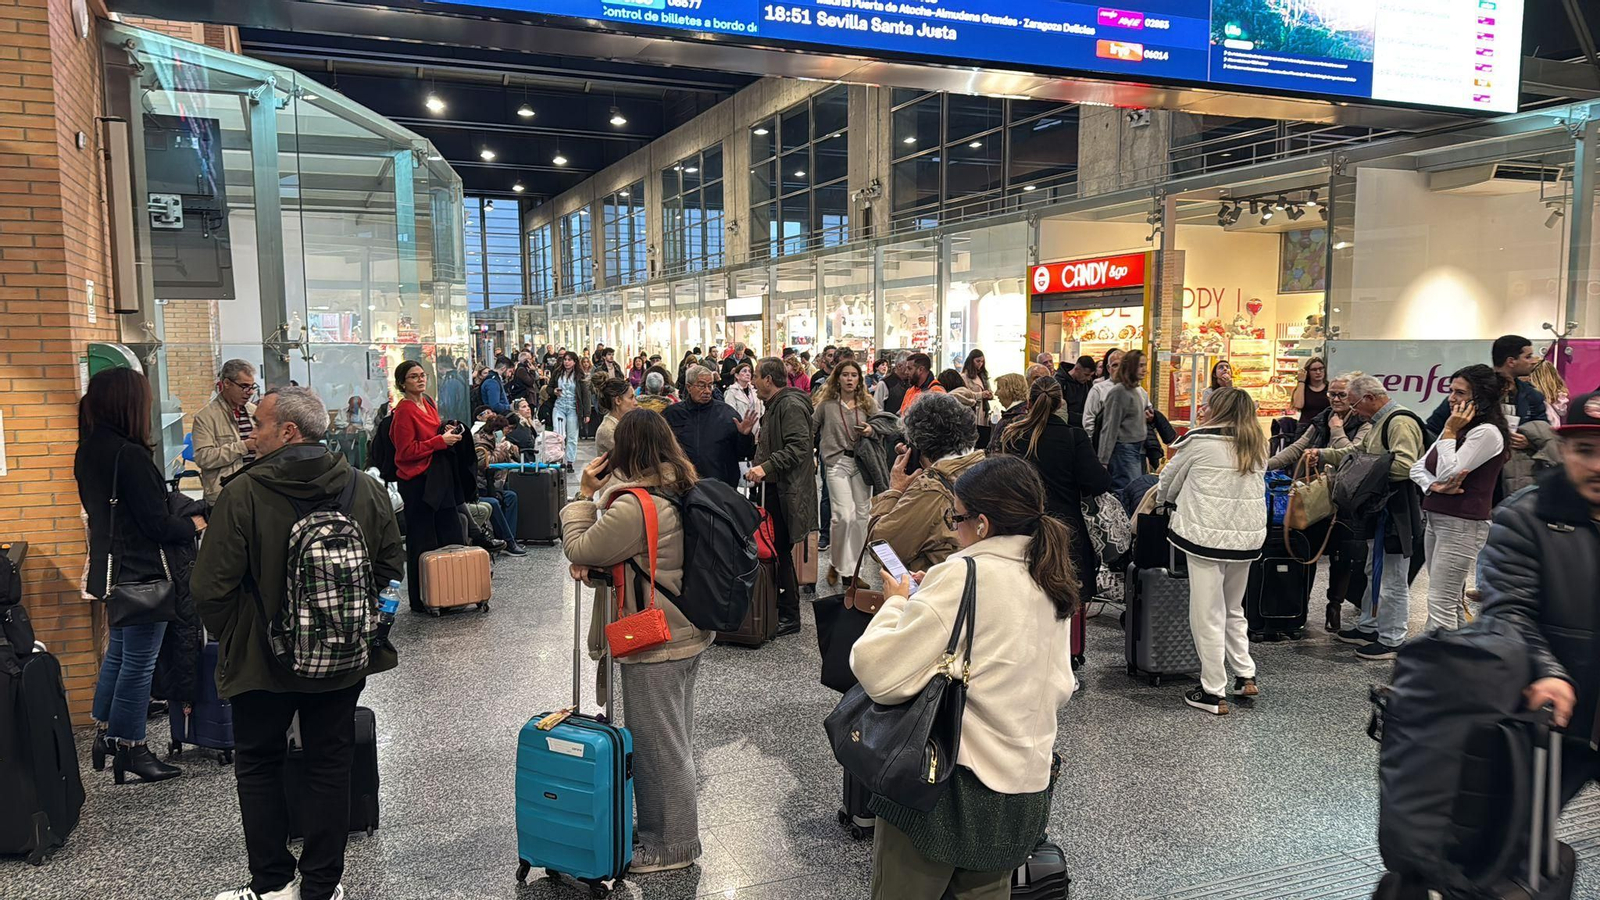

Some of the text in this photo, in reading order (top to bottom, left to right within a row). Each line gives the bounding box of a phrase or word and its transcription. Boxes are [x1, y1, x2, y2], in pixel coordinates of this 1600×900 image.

[644, 11, 658, 22] de
[661, 13, 702, 27] billetes
[704, 20, 711, 28] a
[713, 18, 745, 31] bordo
[764, 4, 957, 40] 18:51 Sevilla Santa Justa
[852, 0, 884, 11] Puerta
[885, 2, 898, 13] de
[981, 13, 1018, 26] Grandes
[1023, 18, 1063, 32] Zaragoza
[1063, 23, 1096, 35] Delicias
[1061, 260, 1128, 288] CANDY &go
